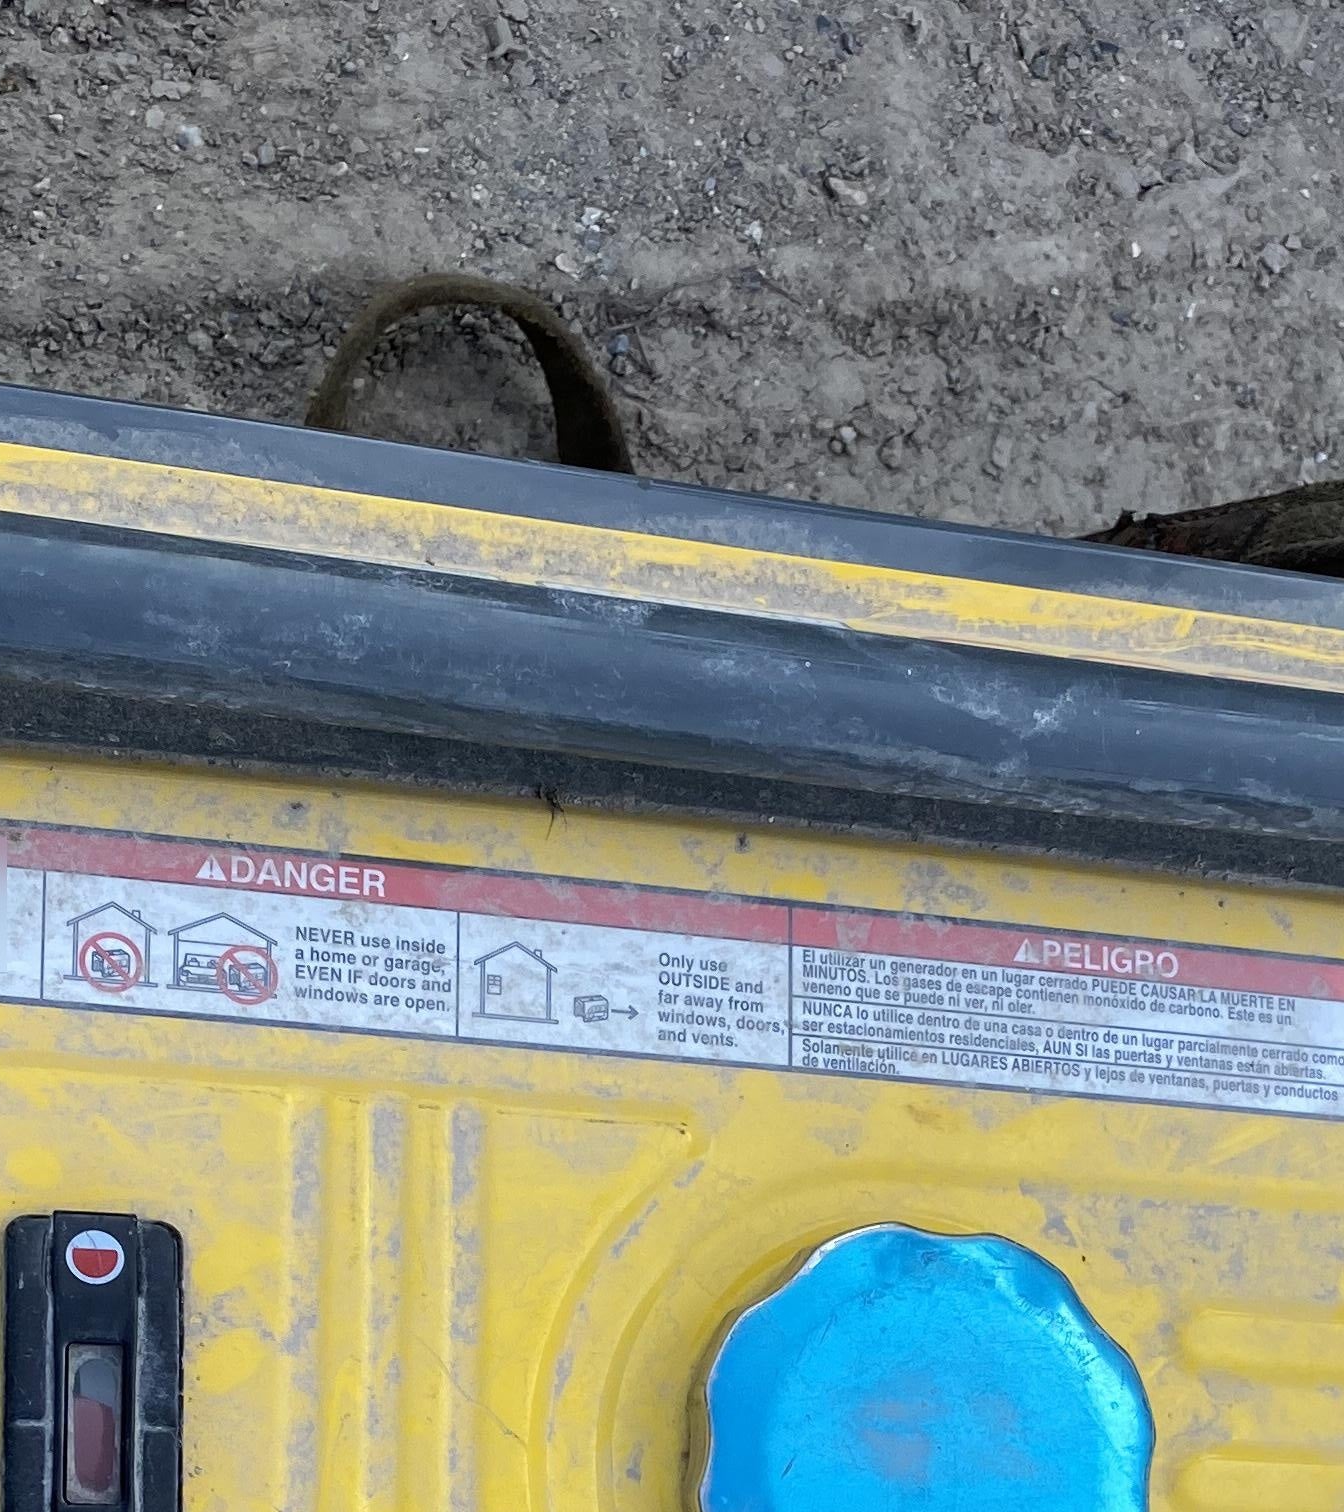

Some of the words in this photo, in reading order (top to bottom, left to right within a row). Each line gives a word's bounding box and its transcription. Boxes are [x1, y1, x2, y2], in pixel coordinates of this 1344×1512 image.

[230, 857, 386, 896] DANGER
[295, 926, 355, 946] NEVER
[360, 936, 390, 949] use
[395, 935, 446, 954] inside
[294, 948, 304, 960] a
[309, 946, 356, 965] home
[360, 954, 379, 967] or
[383, 956, 445, 976] garage,
[658, 952, 694, 974] Only
[698, 959, 727, 973] use
[1042, 940, 1179, 977] PELIGRO
[294, 964, 342, 983] EVEN
[346, 969, 362, 985] IF
[367, 971, 416, 990] doors
[420, 978, 451, 993] and
[658, 972, 730, 992] OUTSIDE
[734, 979, 763, 994] and
[802, 950, 816, 963] El
[818, 952, 866, 968] utilizar
[868, 959, 886, 970] un
[889, 961, 958, 978] generador
[960, 968, 977, 980] en
[980, 970, 998, 982] un
[1000, 969, 1035, 987] lugar
[1037, 976, 1088, 991] cerrado
[1090, 978, 1136, 995] PUEDE
[1139, 983, 1197, 1002] CAUSAR
[1196, 989, 1217, 1004] LA
[1219, 991, 1274, 1009] MUERTE
[1277, 997, 1295, 1012] EN
[294, 984, 368, 1004] windows
[372, 994, 400, 1007] are
[403, 997, 450, 1013] open.
[657, 991, 679, 1007] far
[683, 996, 723, 1013] away
[727, 995, 764, 1012] from
[657, 1009, 730, 1032] windows,
[735, 1014, 785, 1035] doors,
[802, 1001, 853, 1019] NUNCA
[855, 1006, 869, 1021] lo
[871, 1008, 914, 1025] utilice
[916, 1012, 960, 1029] dentro
[962, 1016, 980, 1031] de
[982, 1021, 1008, 1034] una
[1010, 1024, 1042, 1037] casa
[1044, 1027, 1054, 1038] o
[1056, 1025, 1099, 1042] dentro
[1101, 1029, 1118, 1044] de
[1121, 1034, 1138, 1046] un
[1140, 1033, 1174, 1051] lugar
[1176, 1039, 1258, 1057] parcialmente
[1260, 1047, 1308, 1062] cerrado
[1310, 1052, 1344, 1065] como
[657, 1028, 687, 1044] and
[690, 1031, 738, 1047] vents.
